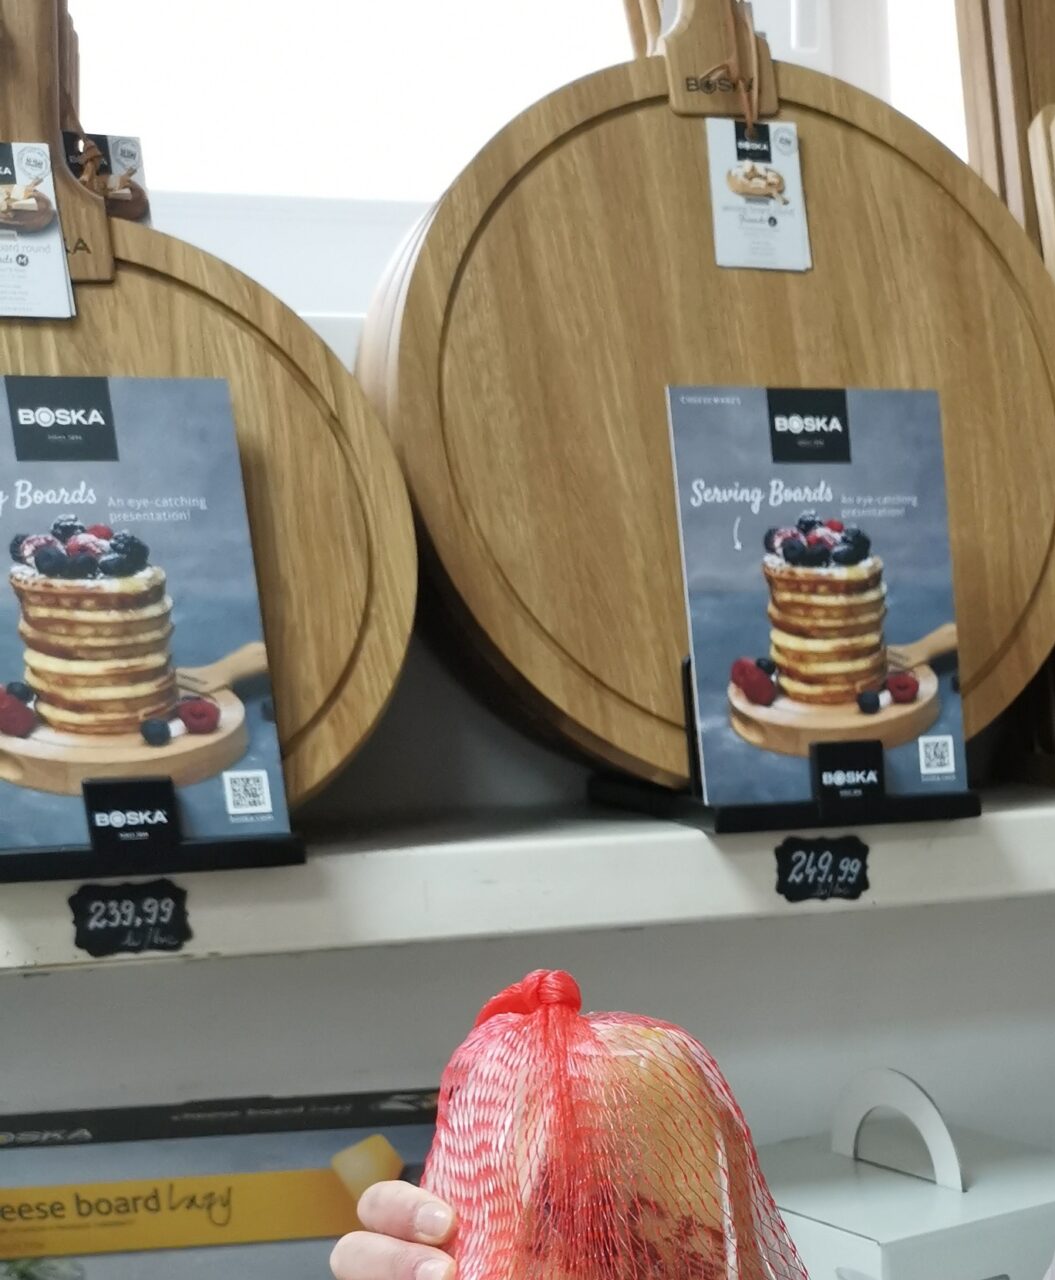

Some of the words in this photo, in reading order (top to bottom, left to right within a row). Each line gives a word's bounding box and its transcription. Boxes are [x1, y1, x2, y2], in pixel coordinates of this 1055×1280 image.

[17, 407, 106, 427] BOSKA
[773, 415, 843, 434] BOSKA
[14, 479, 97, 510] Boards
[127, 496, 207, 511] eye-catching
[689, 478, 765, 514] Serving
[769, 478, 834, 506] Boards
[822, 770, 878, 786] BOSKA
[94, 809, 169, 828] BOSKA
[0, 1200, 66, 1222] eese
[74, 1188, 161, 1218] board
